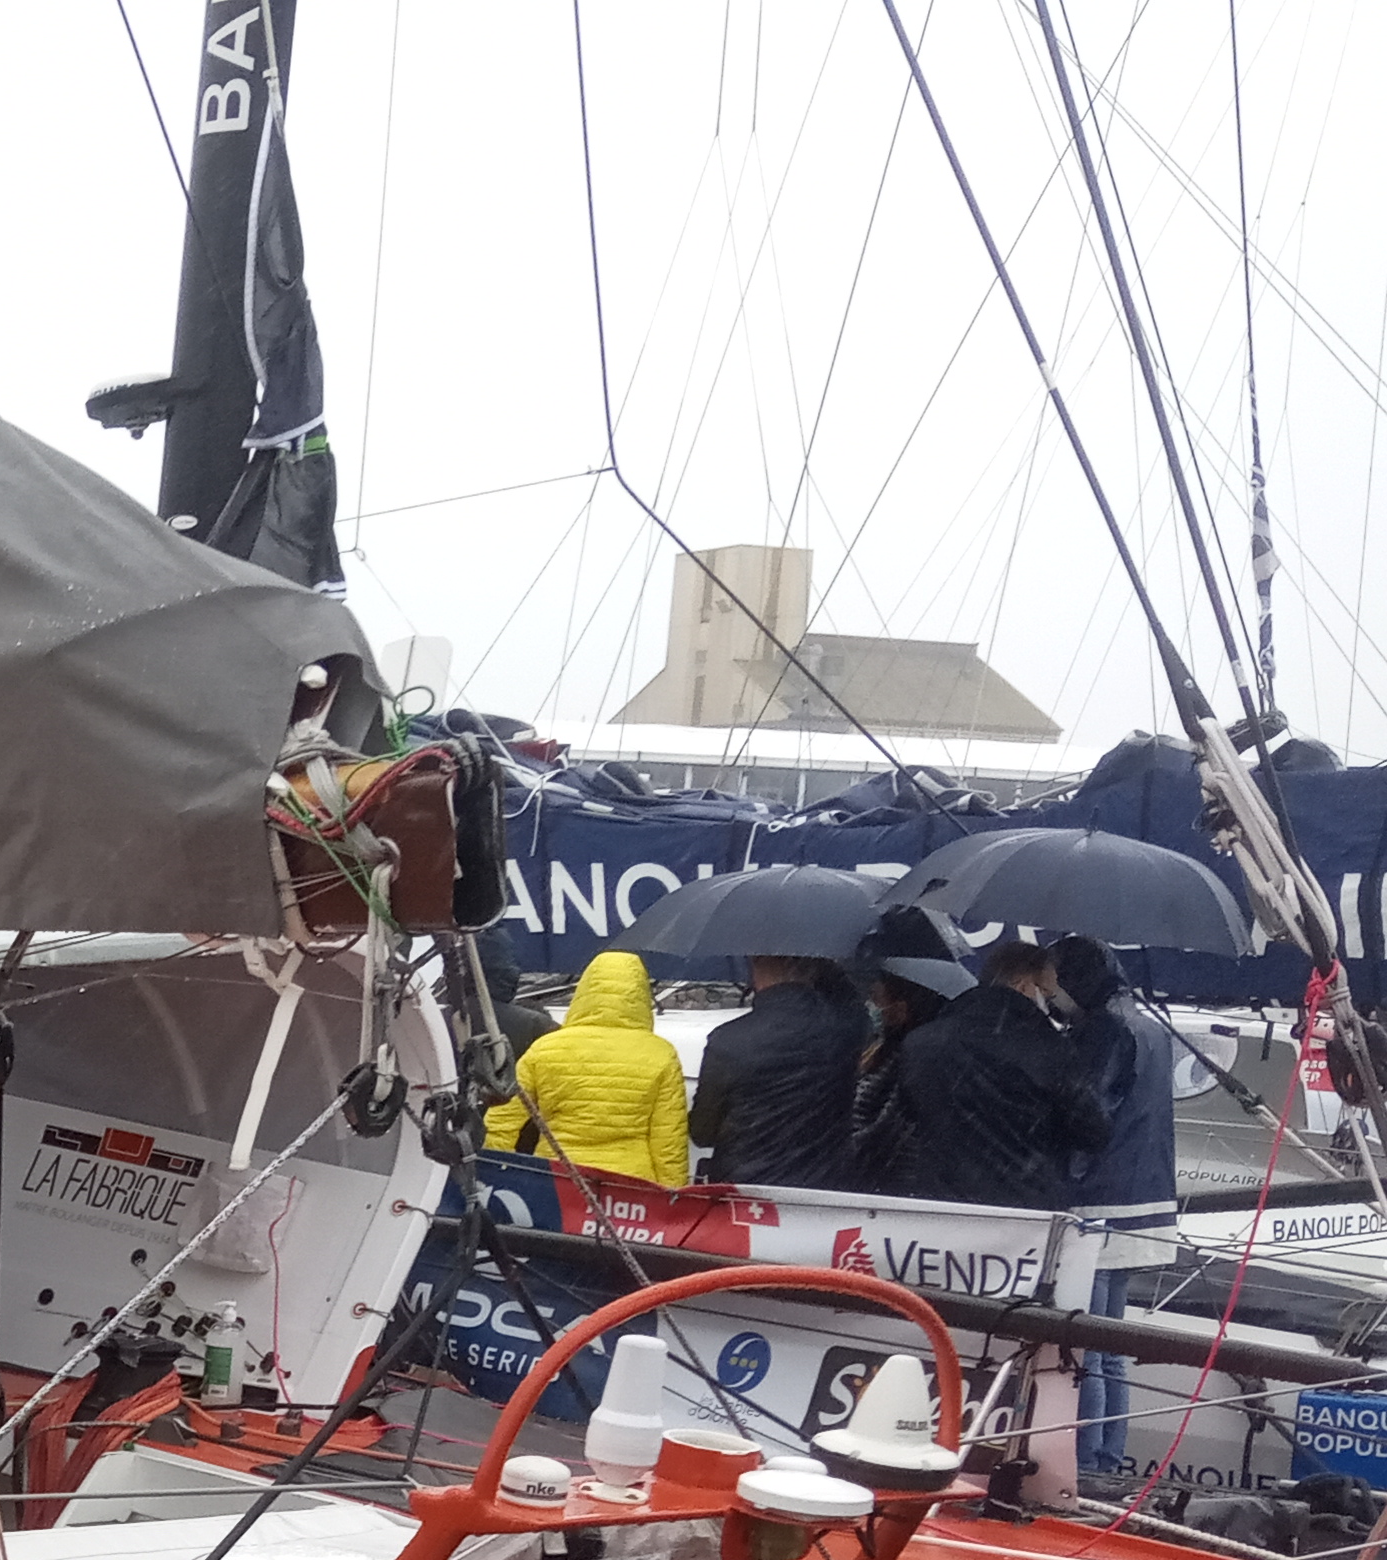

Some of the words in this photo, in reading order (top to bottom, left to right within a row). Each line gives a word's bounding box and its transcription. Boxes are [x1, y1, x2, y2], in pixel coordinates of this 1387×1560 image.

[199, 4, 260, 136] BA
[22, 1149, 61, 1196] LA
[59, 1157, 195, 1226] FABRIQUE
[1273, 1215, 1354, 1242] BANQUE
[1358, 1213, 1387, 1234] POP
[883, 1235, 1044, 1299] VENDÉ
[1296, 1430, 1387, 1459] POPUL
[526, 1482, 556, 1495] nke
